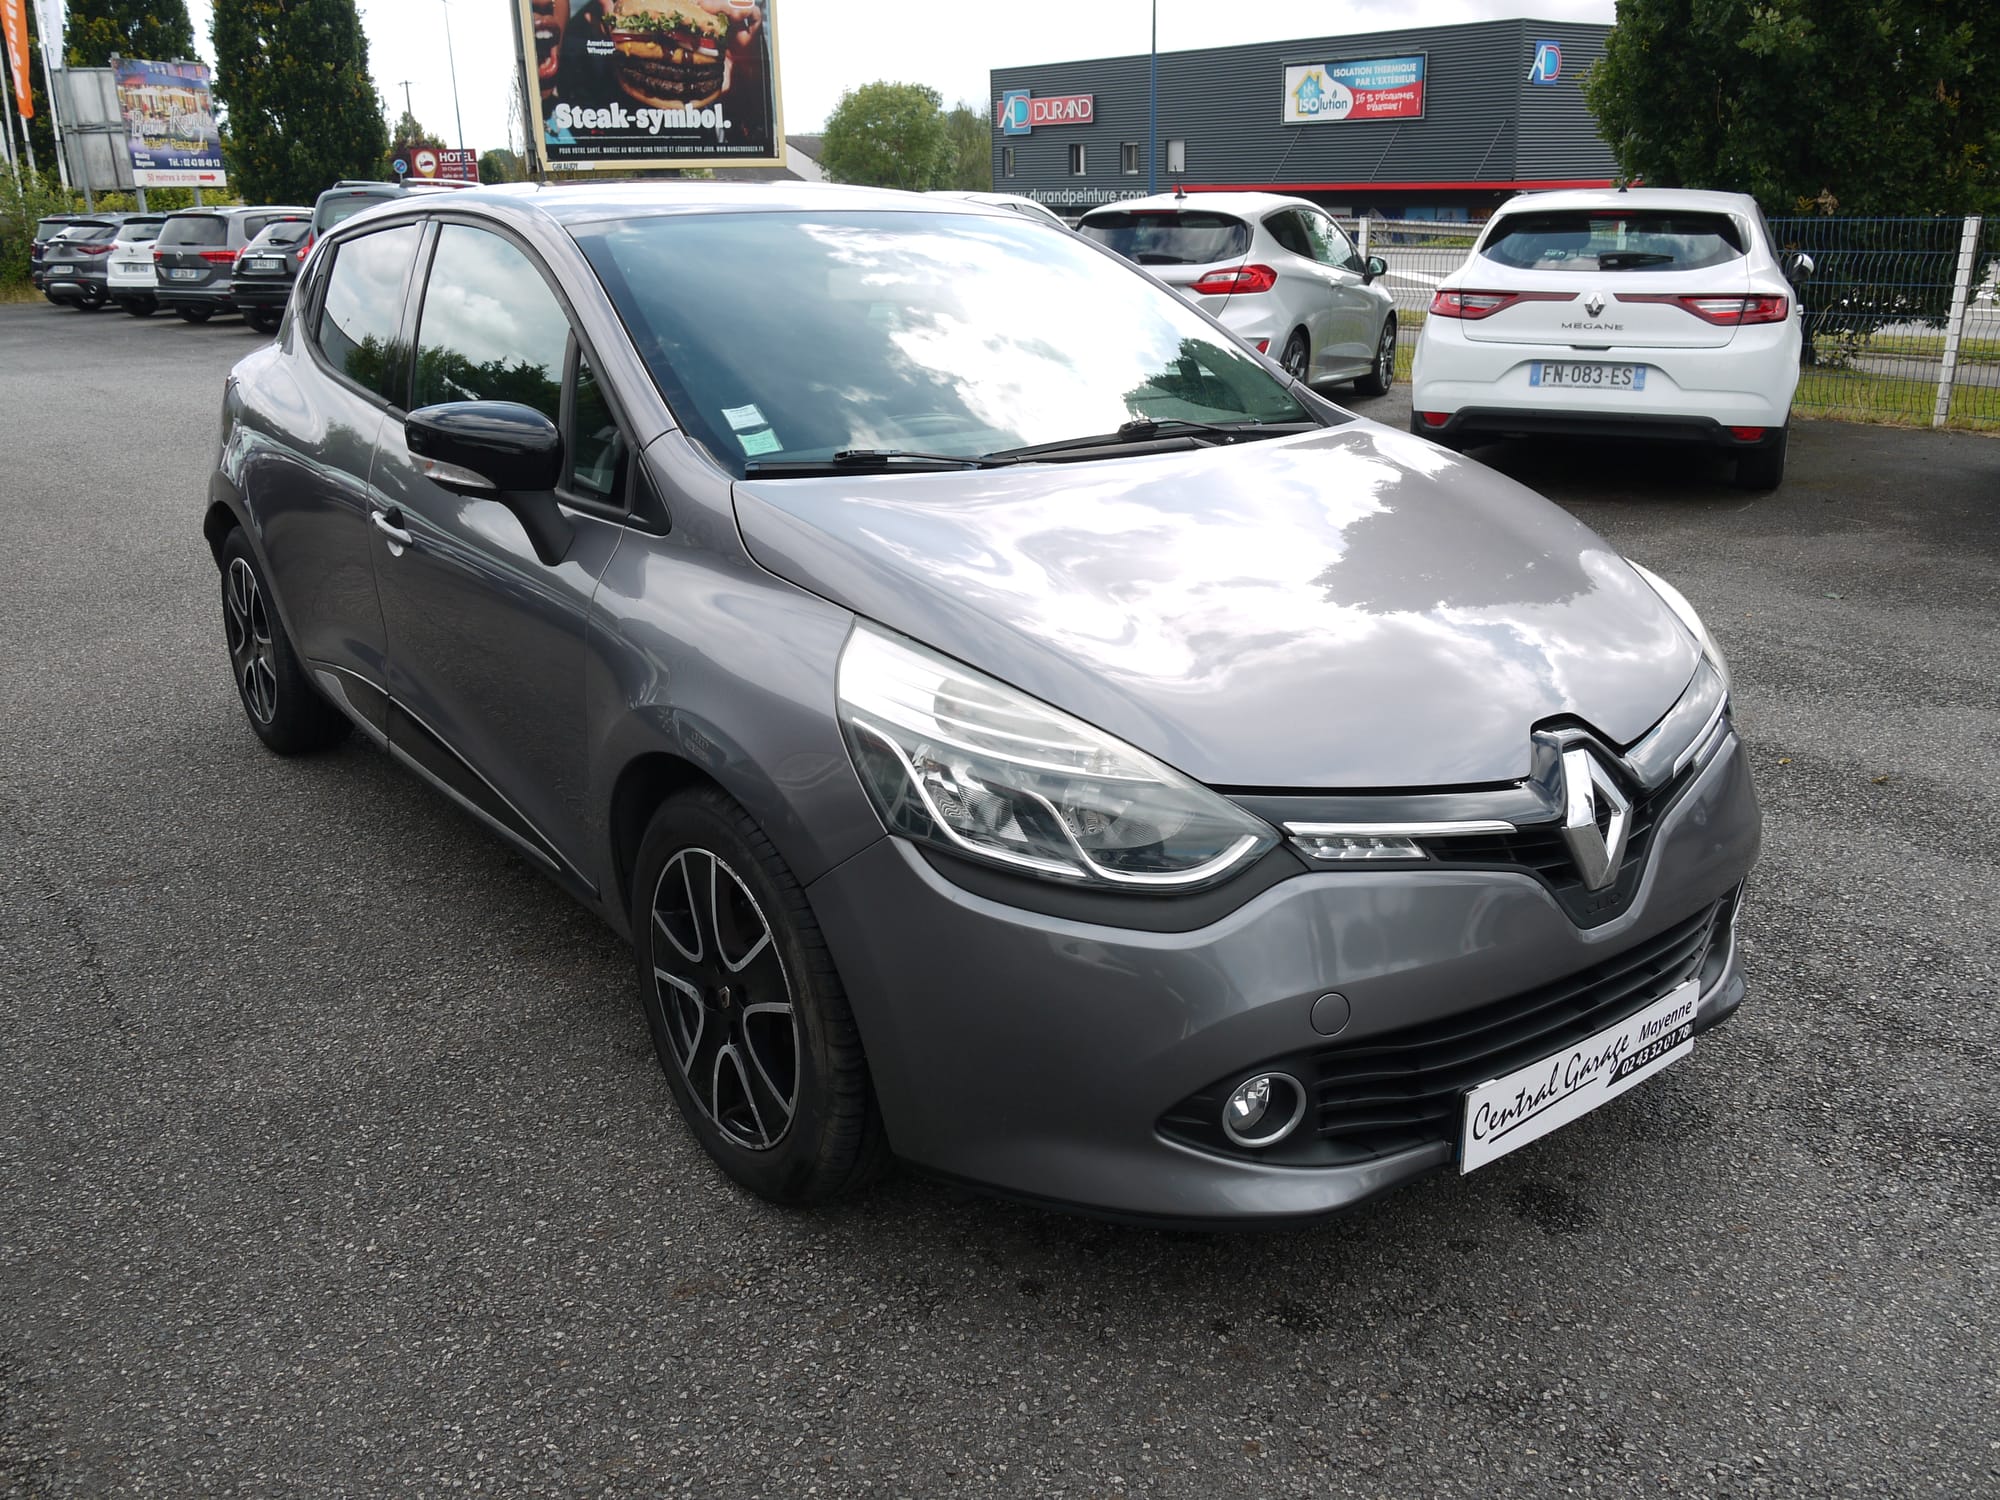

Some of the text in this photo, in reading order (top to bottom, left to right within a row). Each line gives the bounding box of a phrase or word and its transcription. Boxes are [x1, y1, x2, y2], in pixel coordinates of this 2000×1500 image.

[1334, 63, 1417, 77] ISOLATION THERMIQUE
[1355, 77, 1370, 86] PAR
[998, 96, 1091, 128] AD DURAND
[1300, 98, 1347, 112] ISOlution
[555, 102, 732, 134] Steak-symbol.
[171, 138, 208, 151] Restaurant
[439, 151, 474, 162] HOTEL
[1542, 365, 1632, 385] FN-083-ES
[1621, 1023, 1690, 1075] 02 43 32 01 78
[1473, 1001, 1693, 1141] Central Garage Mayenne
